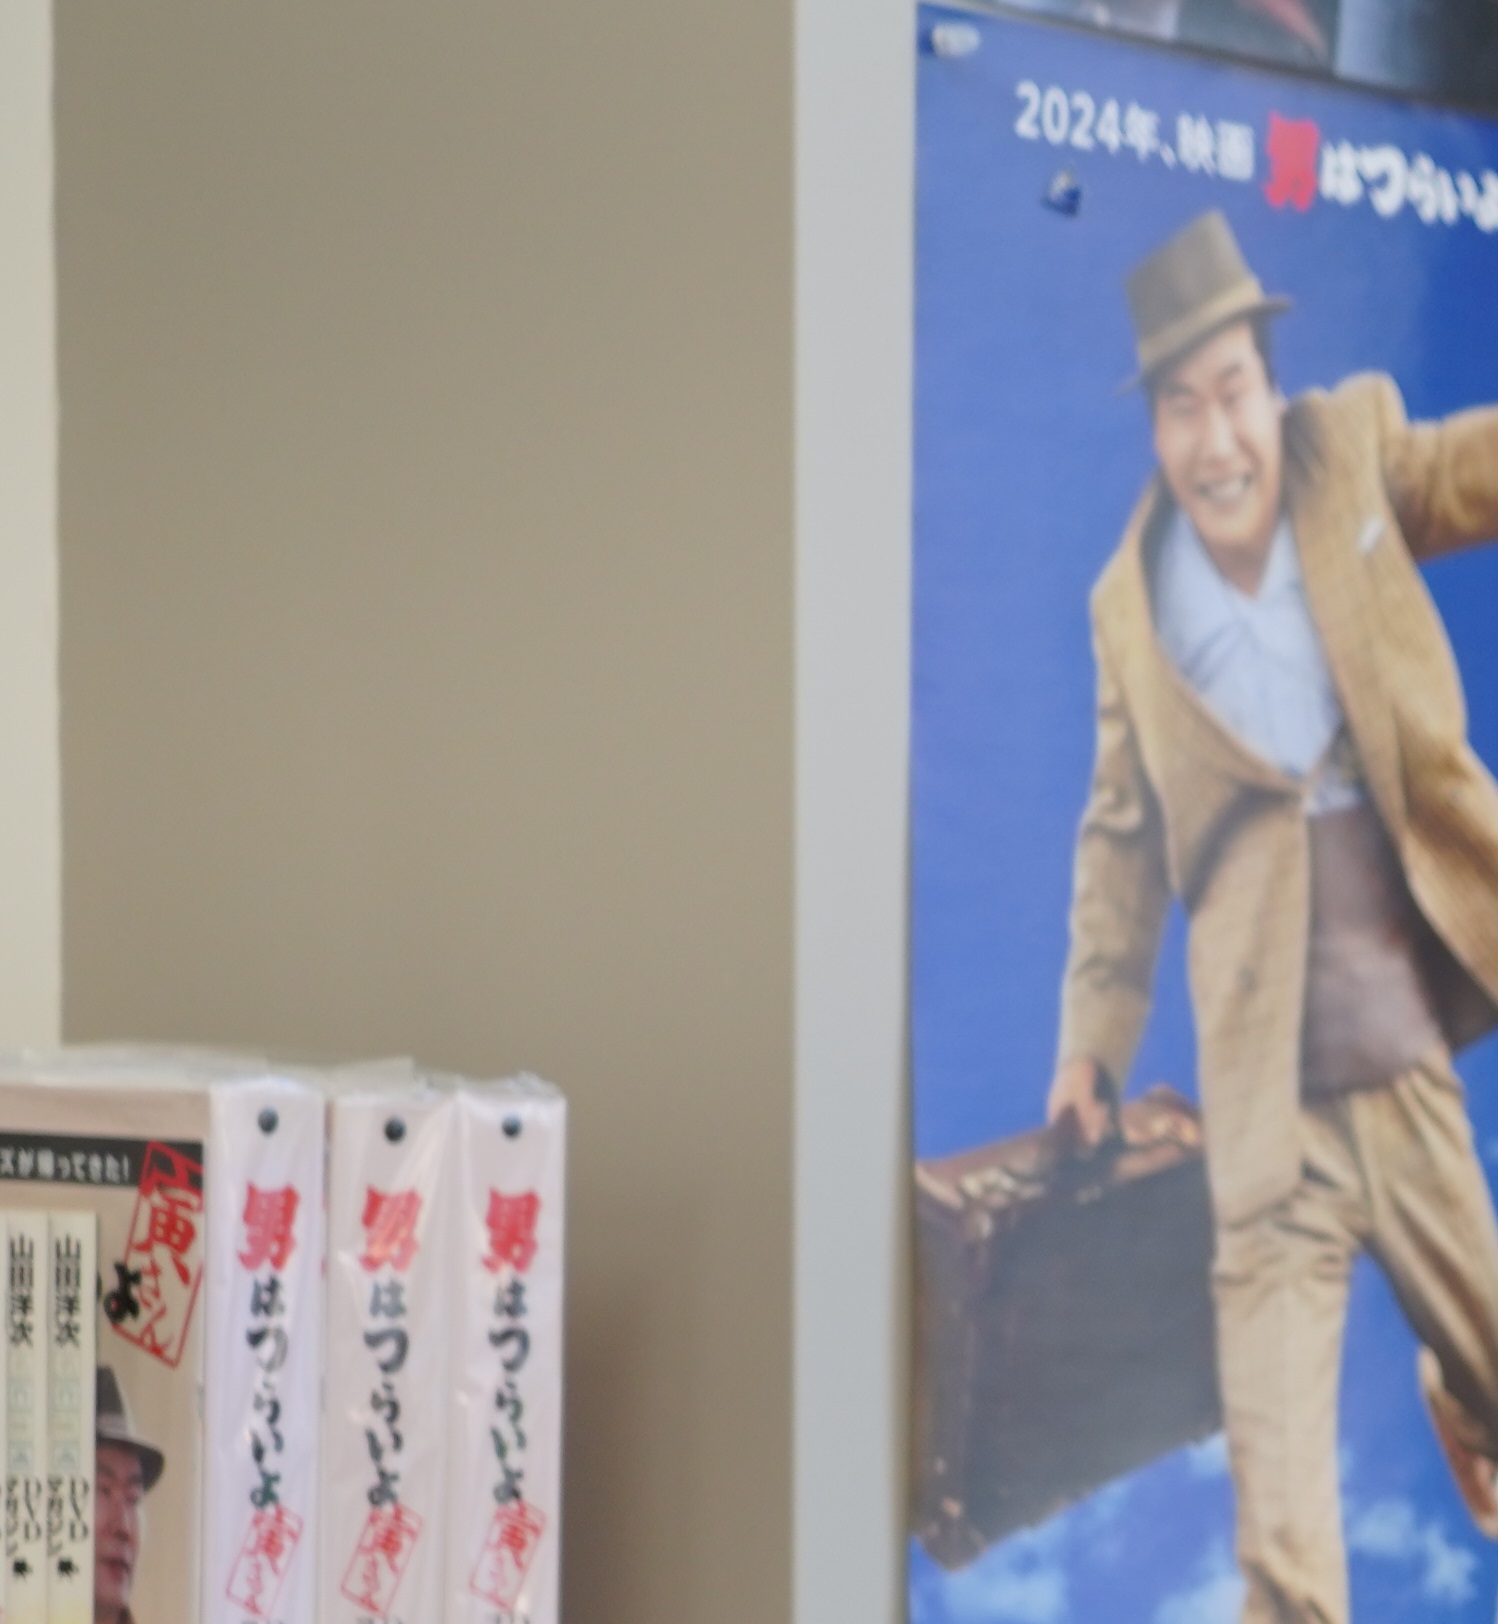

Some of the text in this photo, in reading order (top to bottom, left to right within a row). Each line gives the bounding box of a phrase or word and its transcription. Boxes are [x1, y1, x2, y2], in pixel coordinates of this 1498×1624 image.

[1014, 78, 1255, 183] 2024年、映画
[9, 1234, 35, 1347] 山田洋次
[54, 1233, 81, 1348] 山田洋次
[237, 1180, 300, 1510] 男はつらいよ
[358, 1184, 422, 1509] 男はつらいよ
[481, 1184, 541, 1506] 男はつらいよ
